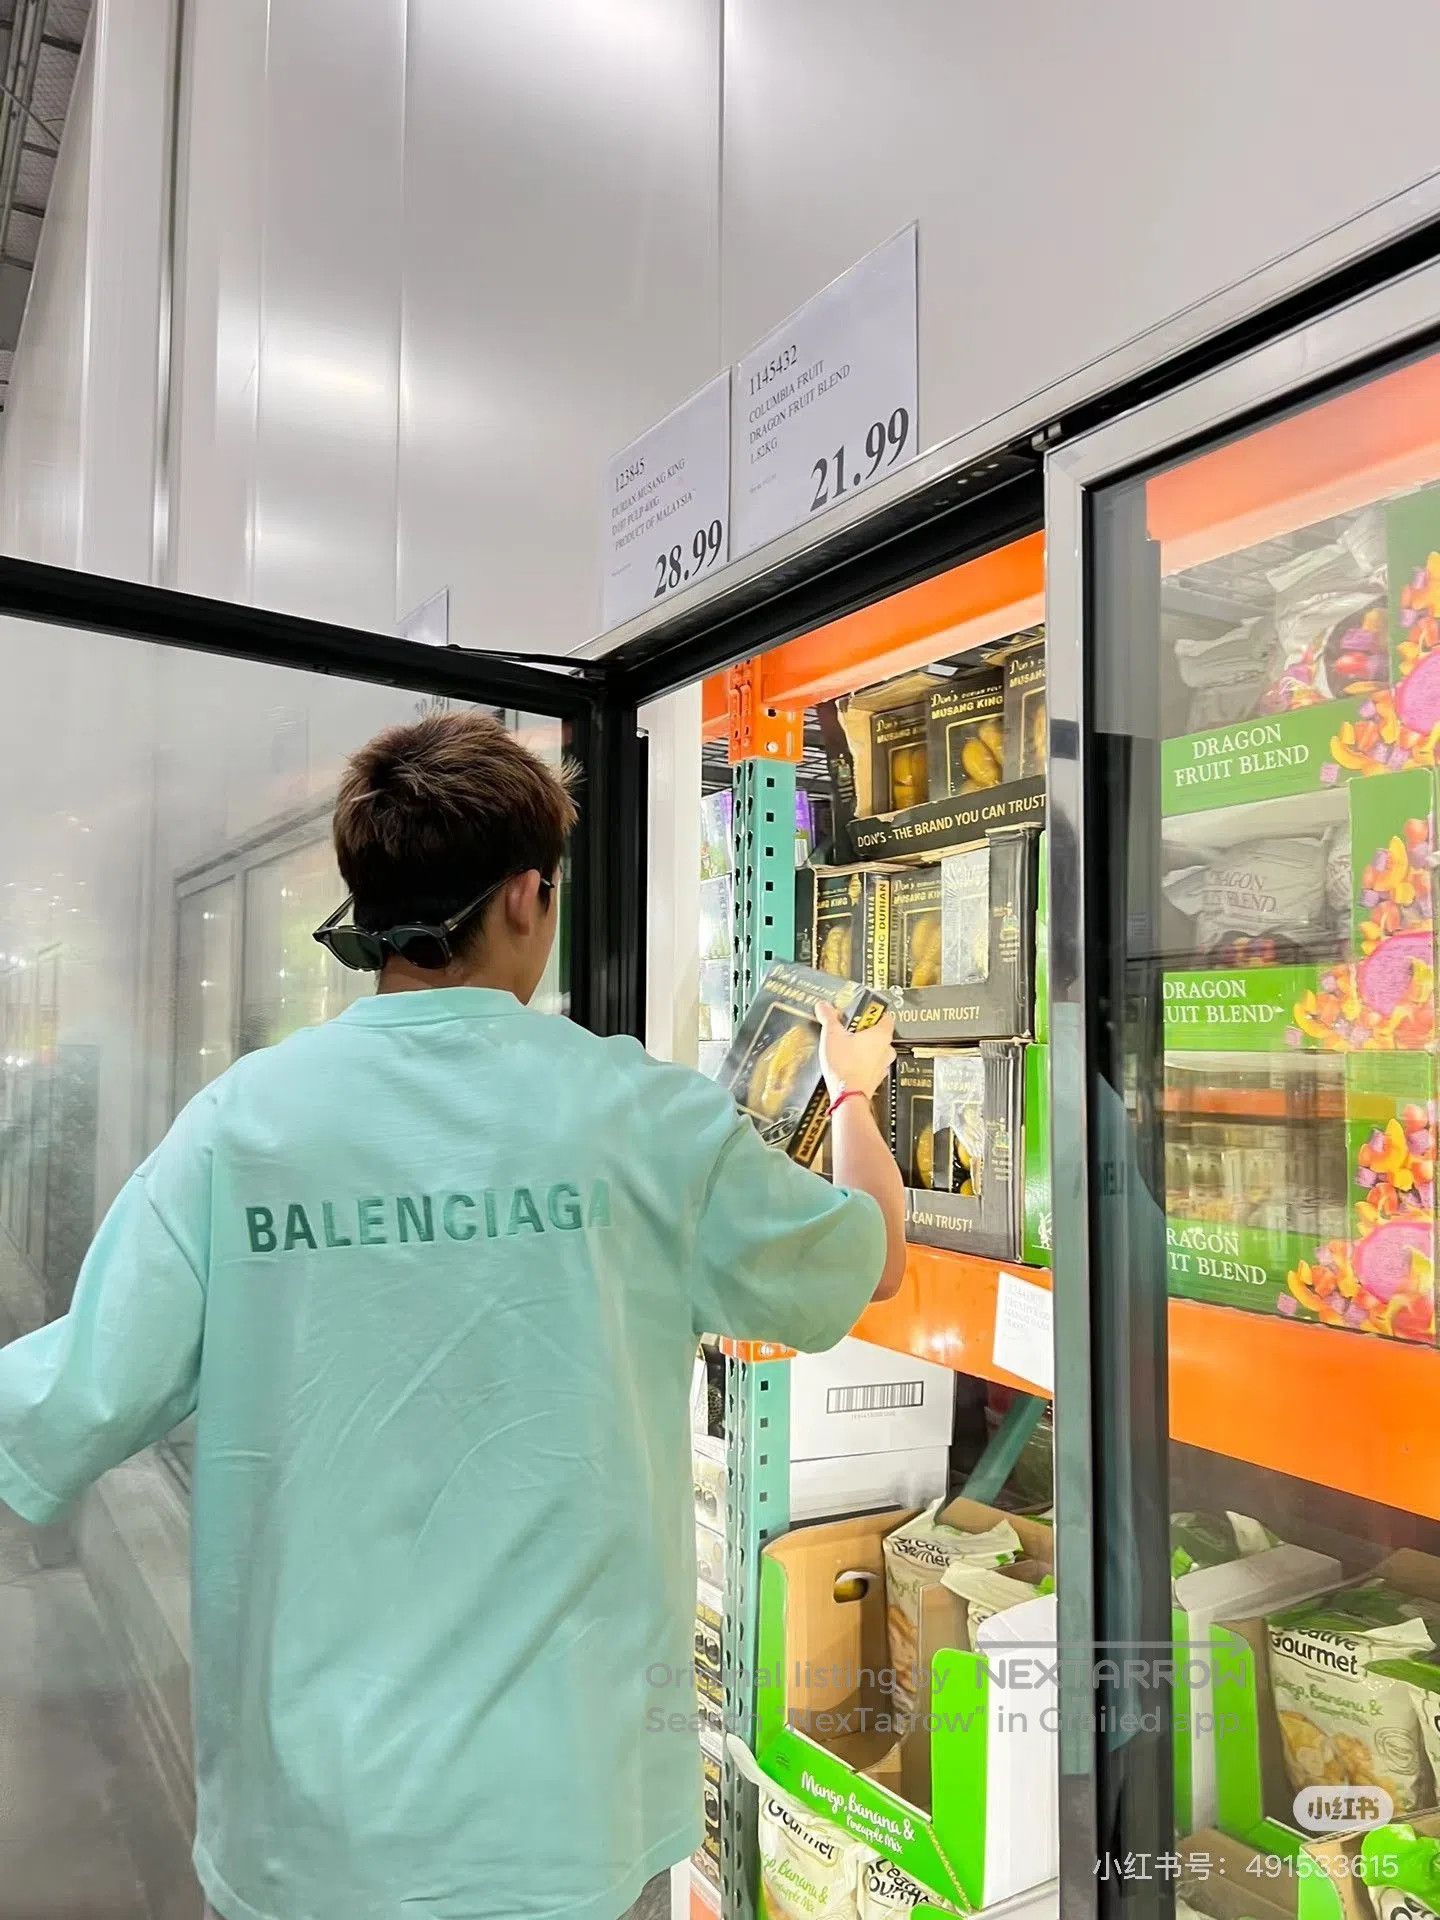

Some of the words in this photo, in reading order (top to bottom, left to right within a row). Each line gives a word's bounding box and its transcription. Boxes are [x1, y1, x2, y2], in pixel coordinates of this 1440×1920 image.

[750, 345, 797, 396] 1145432
[749, 383, 794, 423] COLUMBIA
[797, 360, 824, 389] FRUIT
[749, 410, 786, 443] DRAGON
[788, 388, 814, 418] FRUIT
[818, 364, 850, 396] BLEND
[667, 458, 686, 478] KING
[810, 407, 909, 512] 21.99
[654, 519, 722, 598] 28.99
[931, 701, 974, 720] MUSANG
[977, 695, 1003, 709] KING
[1192, 724, 1281, 759] DRAGON
[1174, 760, 1233, 787] FRUIT
[1238, 744, 1309, 775] BLEND
[857, 831, 887, 848] DON'S
[892, 826, 913, 840] THE
[915, 817, 953, 836] BRAND
[954, 809, 979, 827] YOU
[981, 804, 1006, 820] CAN
[1163, 980, 1246, 999] DRAGON
[899, 1010, 920, 1022] YOU
[921, 1008, 941, 1021] CAN
[943, 1006, 980, 1020] TRUST!
[1206, 1004, 1274, 1024] BLEND
[245, 1178, 611, 1252] BALENCIAGA
[913, 1210, 933, 1226] CAN
[935, 1214, 973, 1232] TRUST!
[1197, 1257, 1267, 1286] BLEND
[903, 1819, 915, 1841] &
